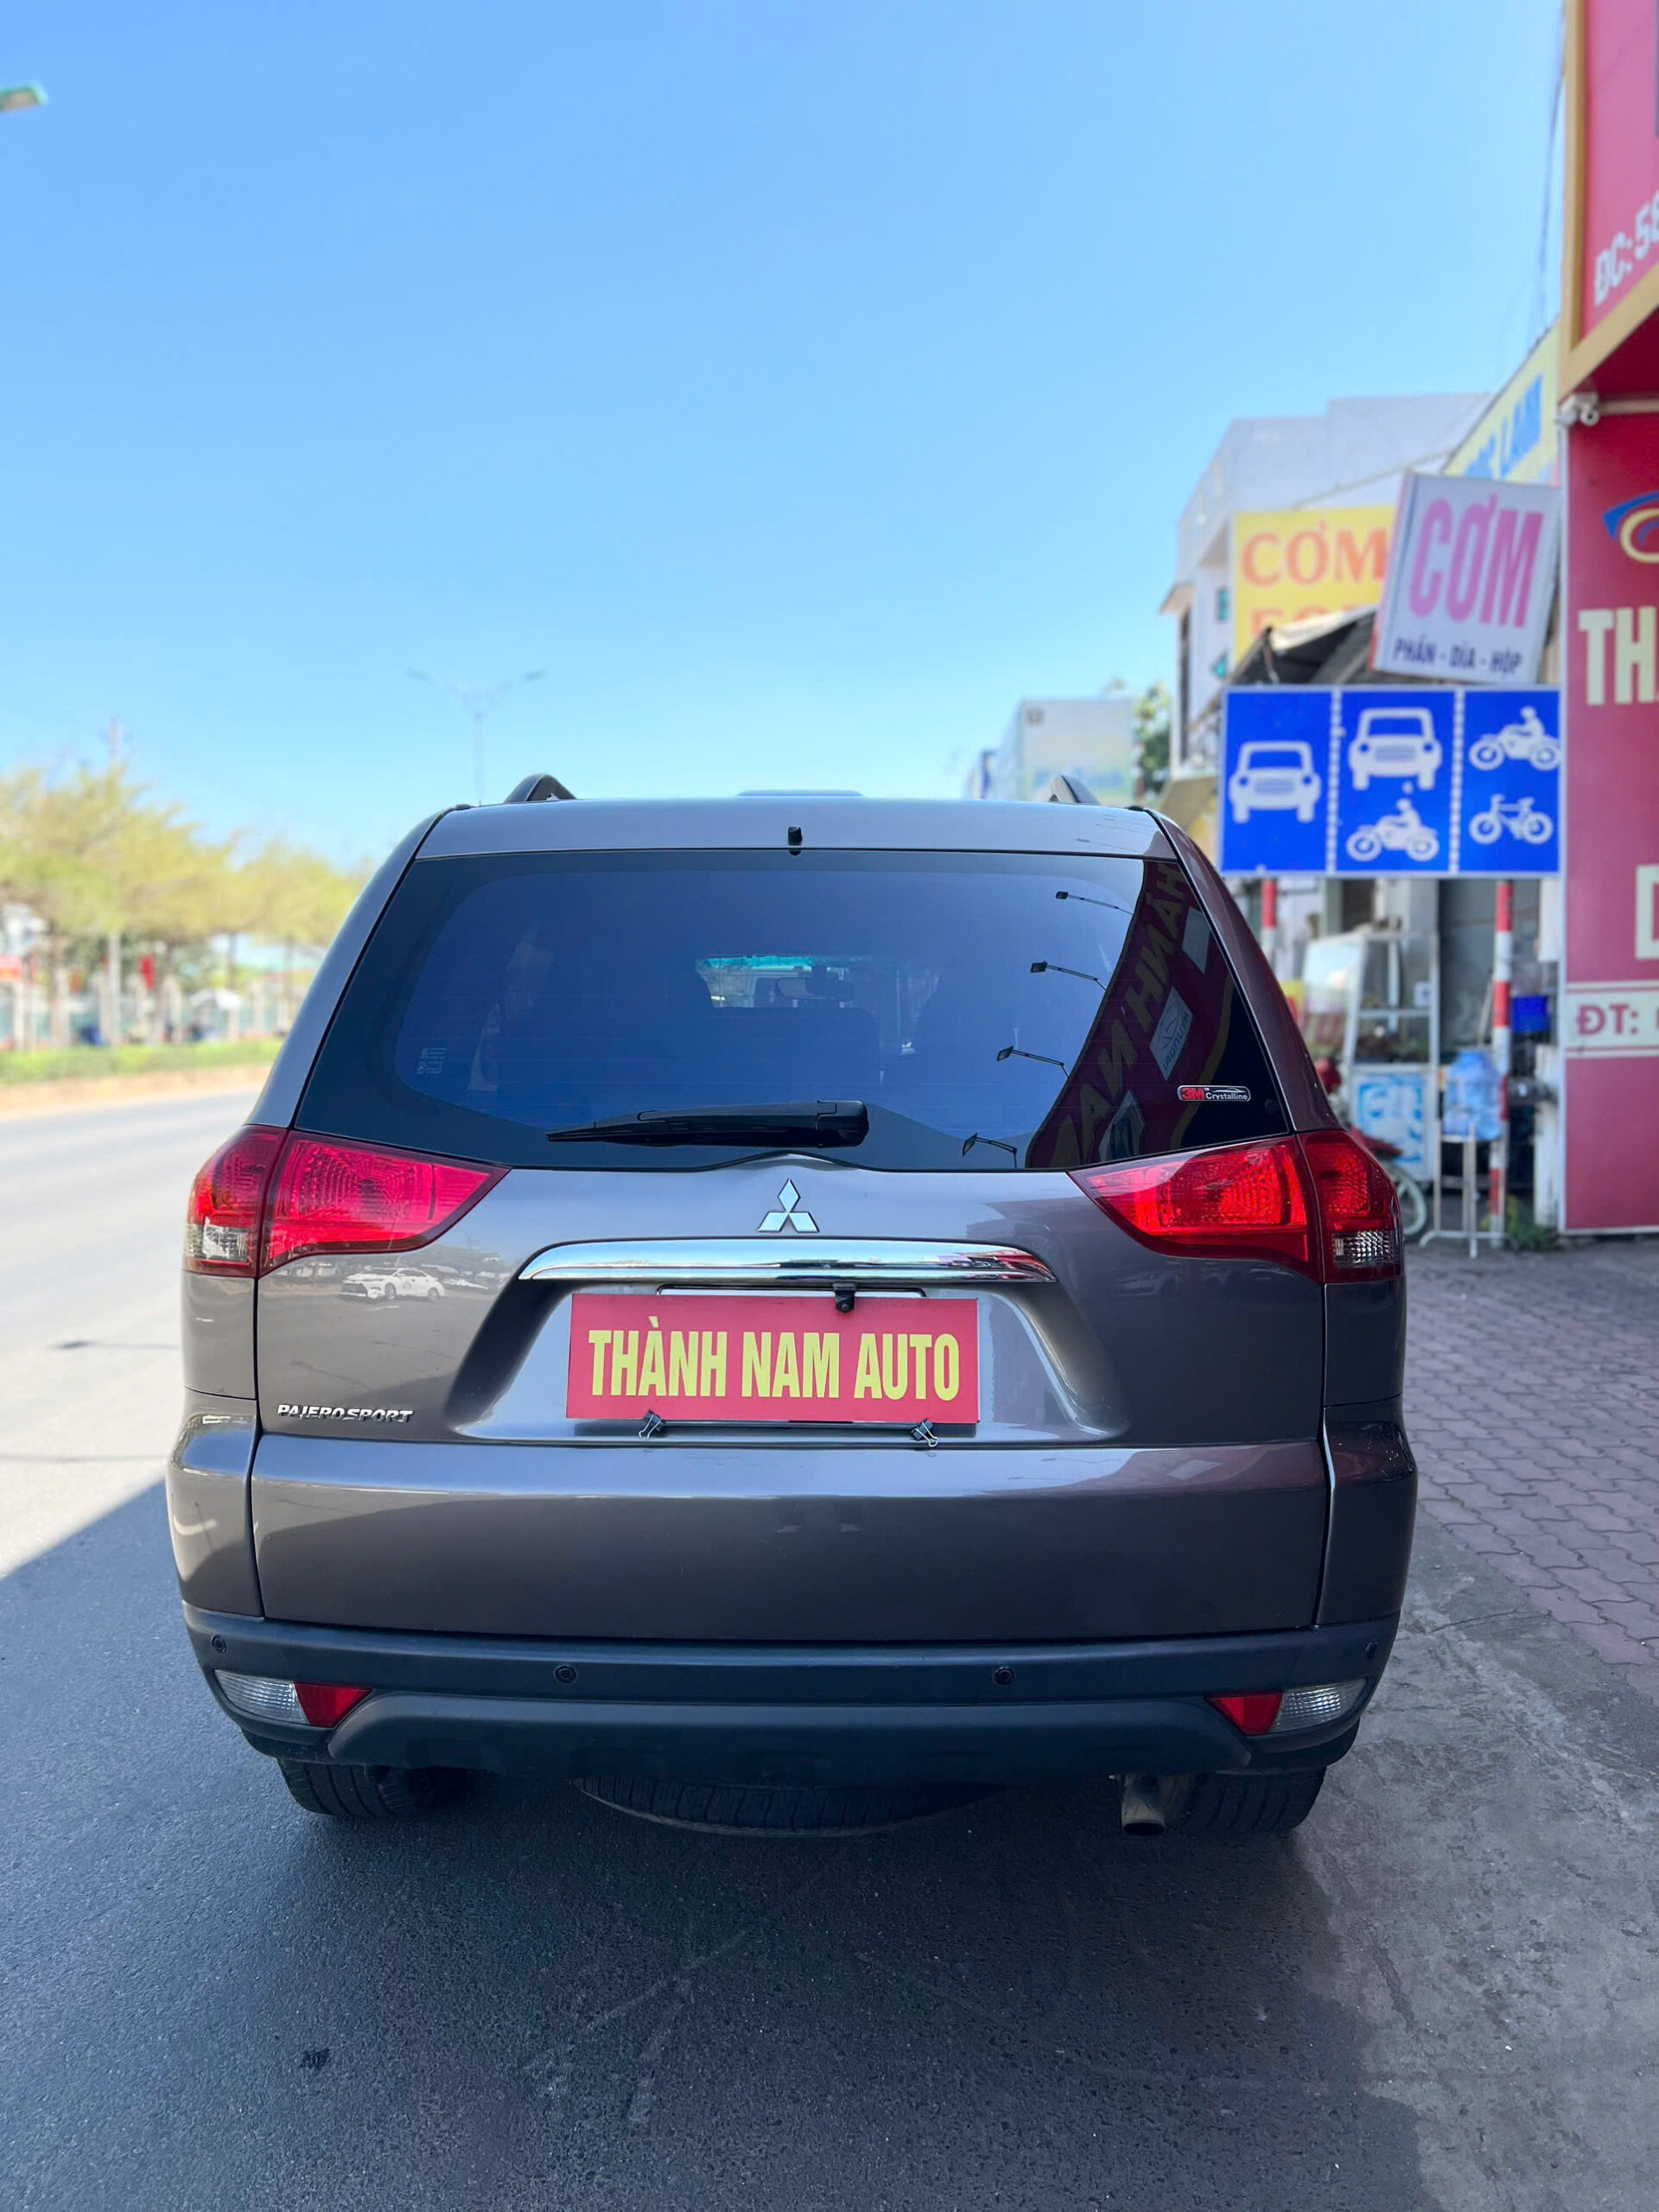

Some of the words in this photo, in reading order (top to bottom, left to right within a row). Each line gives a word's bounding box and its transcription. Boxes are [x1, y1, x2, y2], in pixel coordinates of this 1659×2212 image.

[1409, 493, 1544, 627] CƠM
[1578, 606, 1659, 705] TH
[1576, 1003, 1638, 1035] ĐT:
[1181, 1087, 1205, 1100] 3M
[1205, 1092, 1248, 1102] Crystalline
[588, 1316, 728, 1396] THÀNH
[741, 1332, 840, 1399] NAM
[854, 1333, 959, 1402] AUTO
